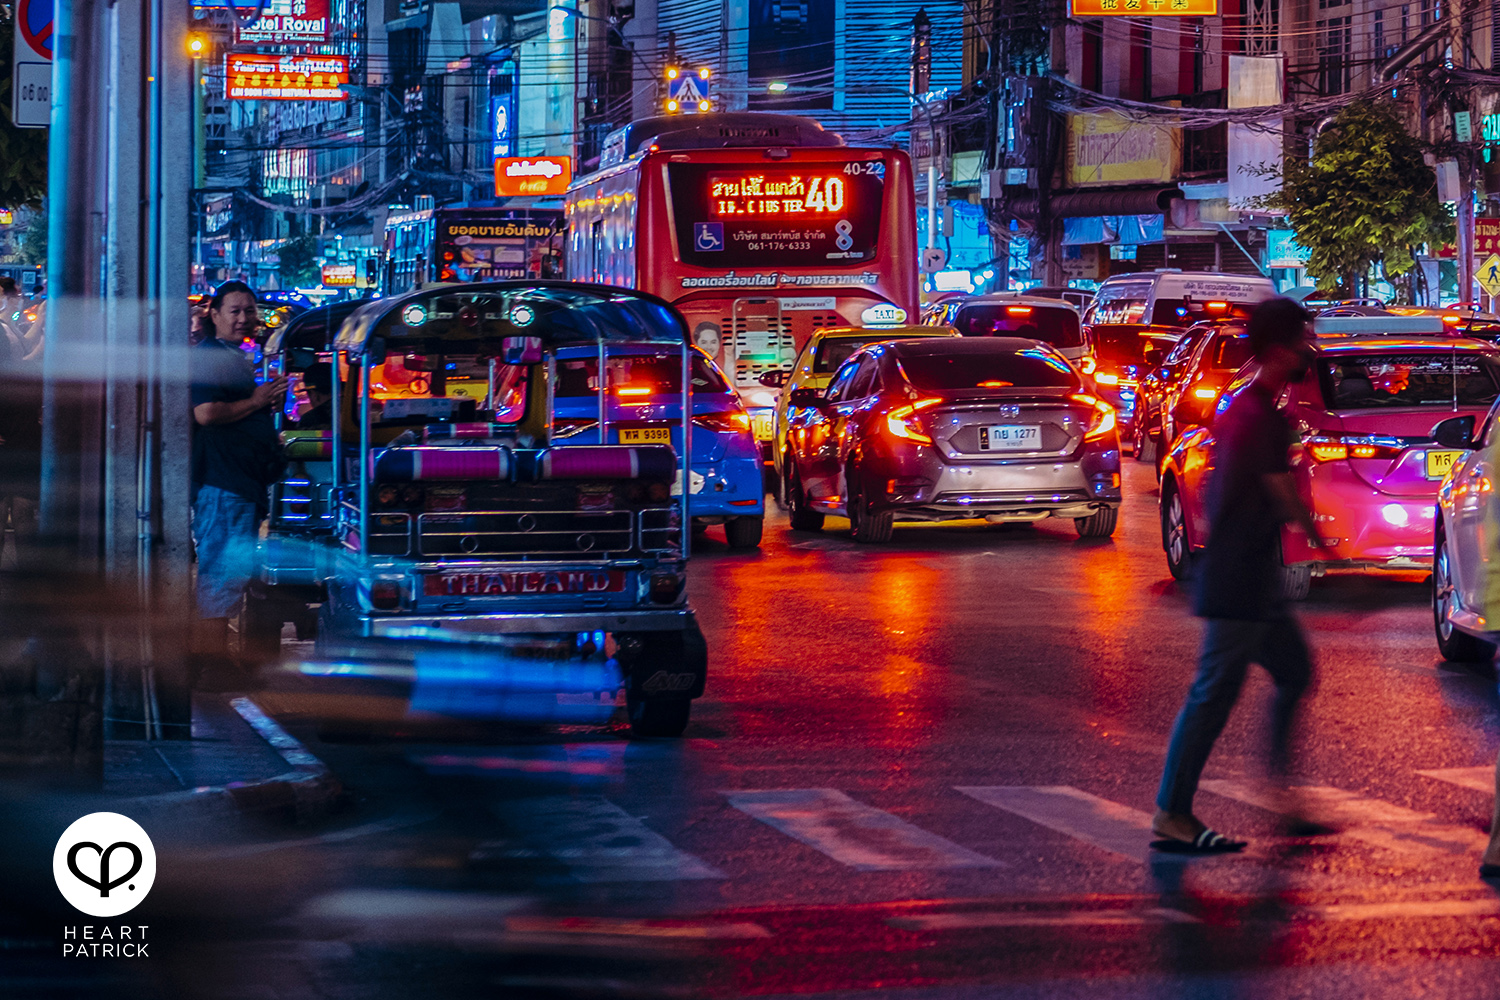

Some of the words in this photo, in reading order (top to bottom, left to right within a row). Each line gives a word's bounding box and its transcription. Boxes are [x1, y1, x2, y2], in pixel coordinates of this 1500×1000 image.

[240, 16, 280, 31] otel
[282, 16, 326, 32] Royal
[843, 162, 886, 175] 40-22
[804, 177, 844, 212] 40
[732, 230, 758, 241] บริษัท
[804, 229, 826, 241] จำกัด
[748, 241, 811, 250] 061-176-6333
[796, 271, 878, 286] กองสลากพลัส
[874, 310, 894, 319] TAXI
[644, 429, 669, 439] 9398
[1014, 428, 1036, 438] 1277
[441, 572, 610, 594] THAILAND
